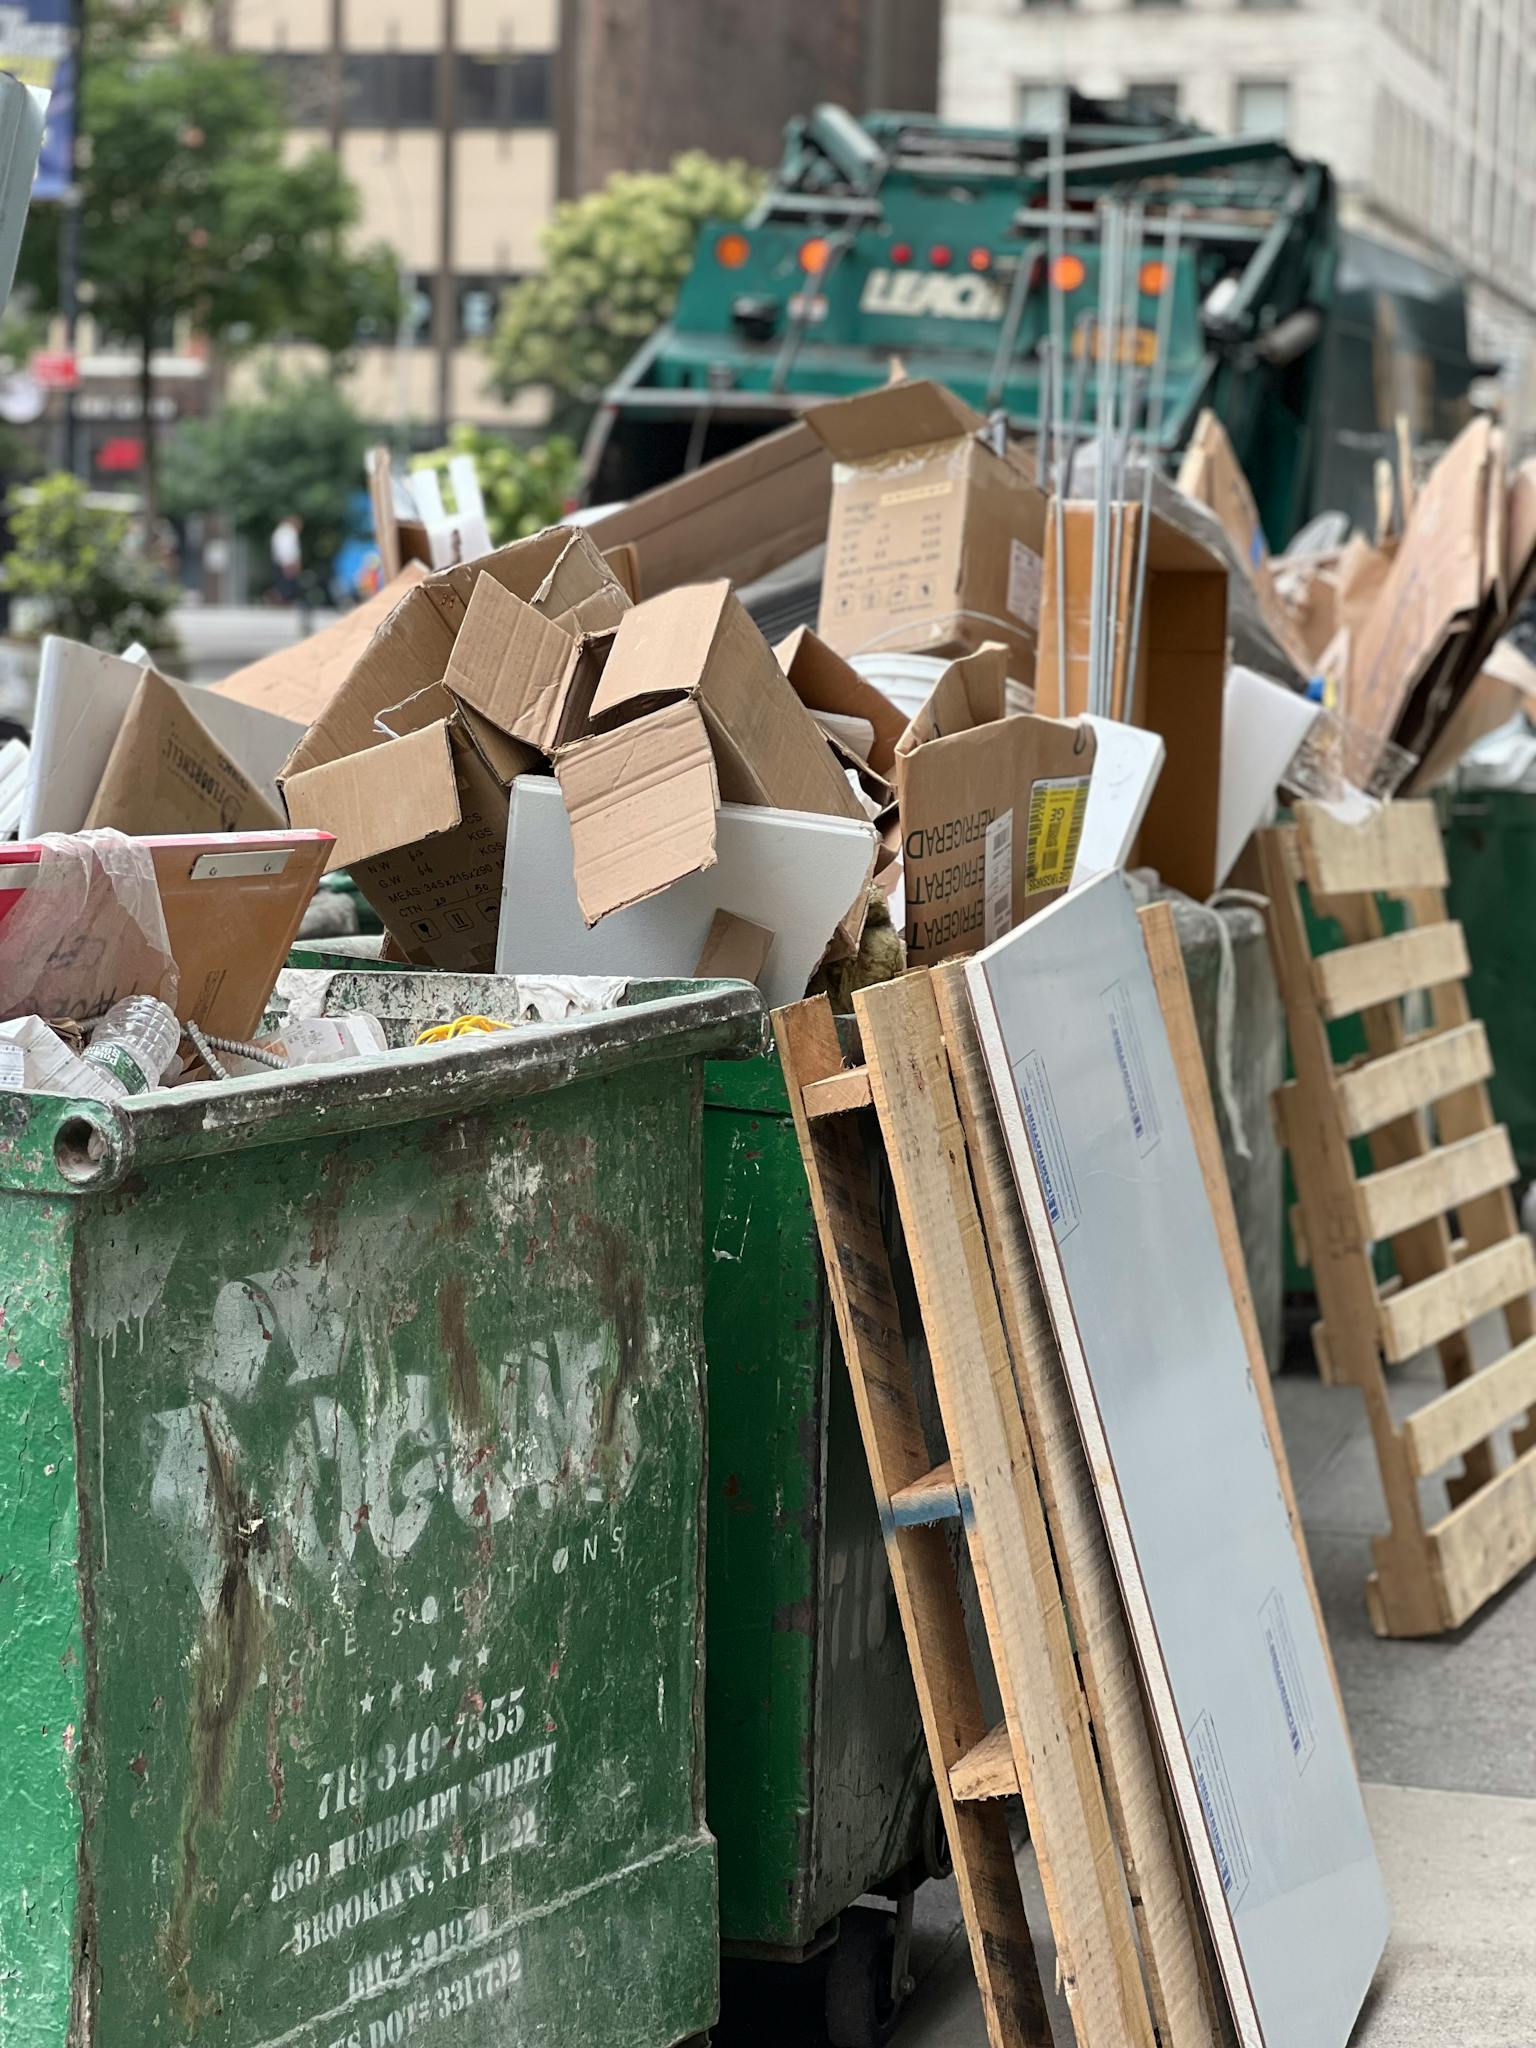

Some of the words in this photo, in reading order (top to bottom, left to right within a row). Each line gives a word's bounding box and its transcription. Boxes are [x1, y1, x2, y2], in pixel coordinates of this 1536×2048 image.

[467, 827, 494, 841] KGS
[399, 904, 424, 919] CTN
[270, 1852, 321, 1903] 860
[468, 1742, 557, 1812] STREET
